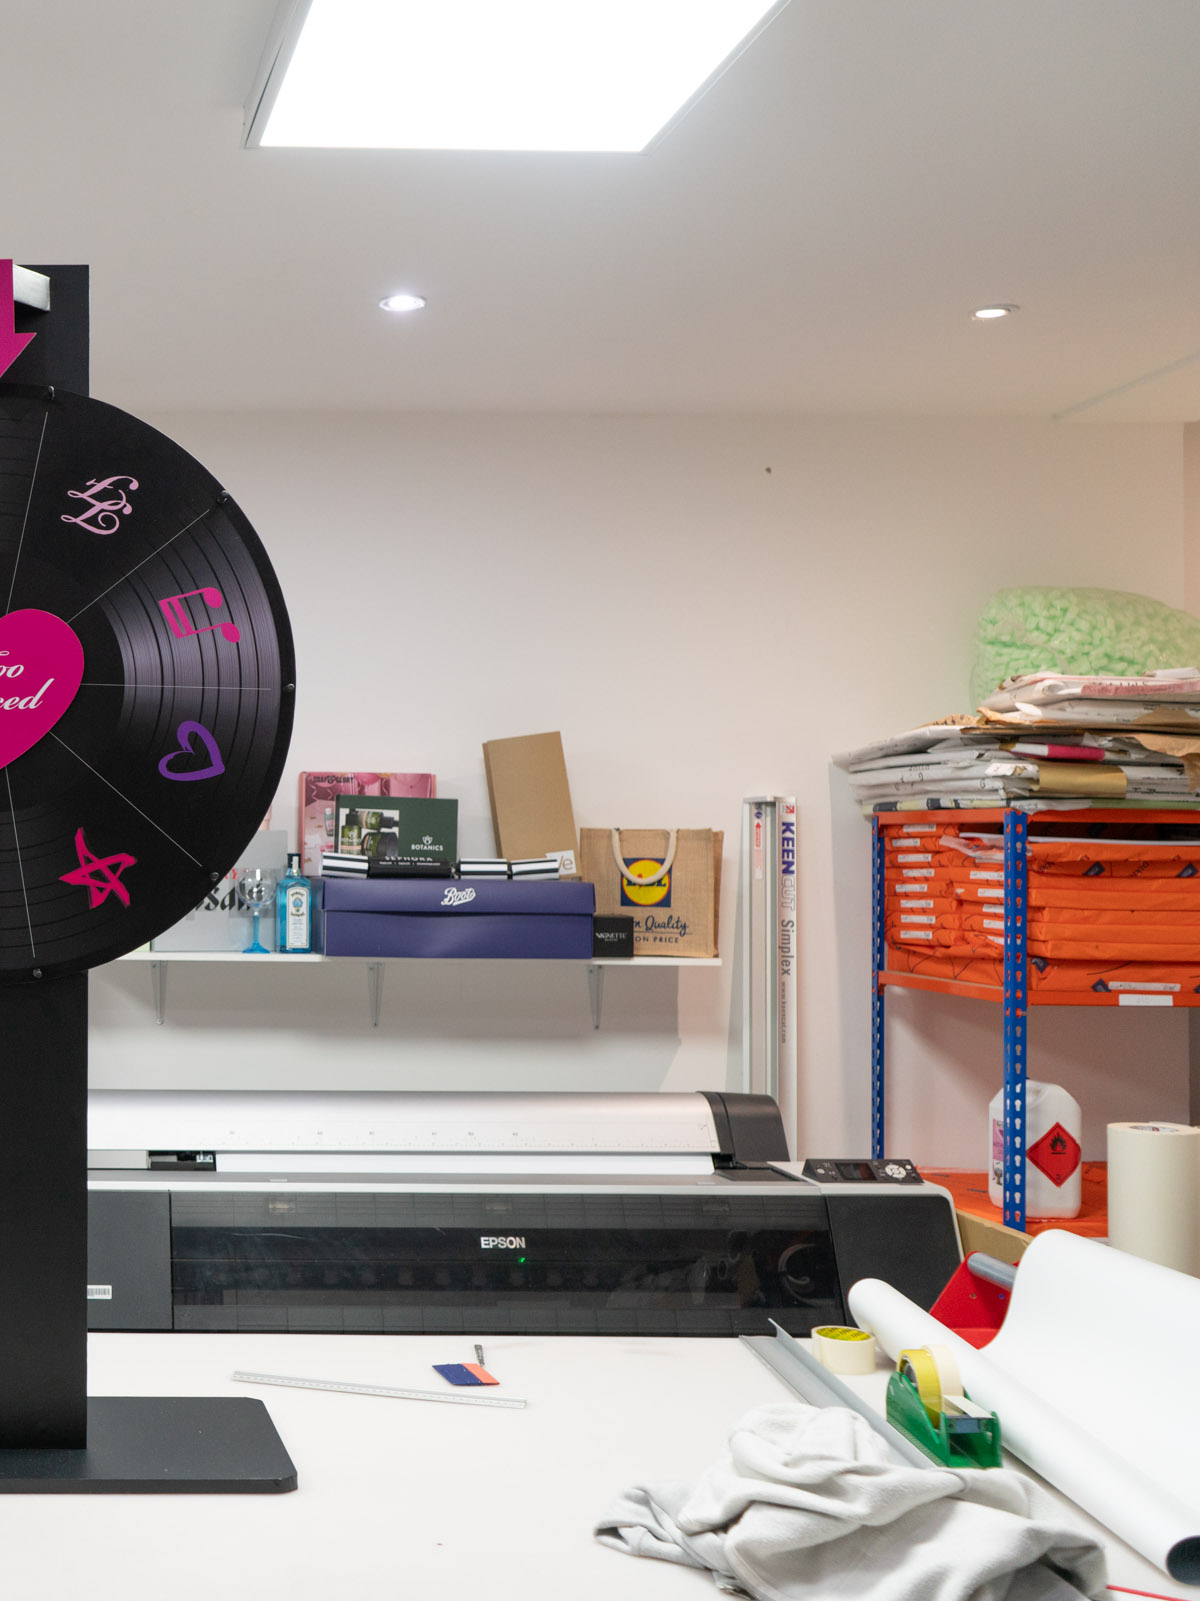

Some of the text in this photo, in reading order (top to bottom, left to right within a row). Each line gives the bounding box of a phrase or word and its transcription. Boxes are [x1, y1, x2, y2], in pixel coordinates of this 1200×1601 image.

[781, 821, 795, 911] KEENCUT
[441, 887, 477, 906] Boots
[645, 914, 688, 937] Quality
[653, 936, 679, 944] PRICE
[779, 919, 795, 976] Simplex
[481, 1237, 526, 1248] EPSON
